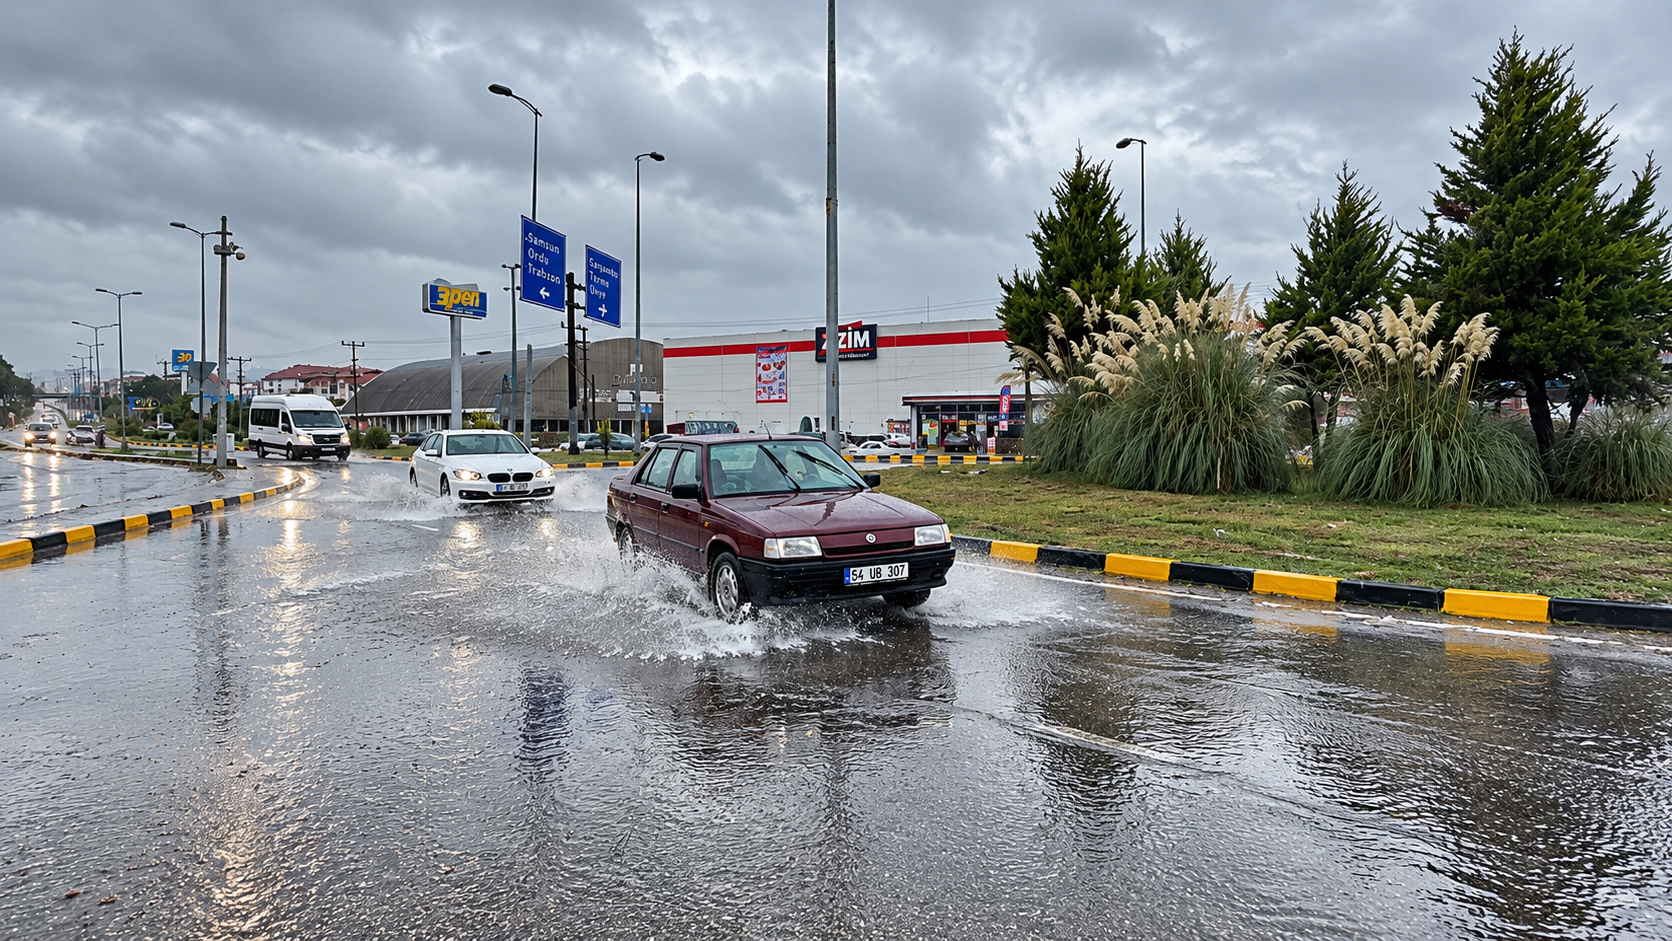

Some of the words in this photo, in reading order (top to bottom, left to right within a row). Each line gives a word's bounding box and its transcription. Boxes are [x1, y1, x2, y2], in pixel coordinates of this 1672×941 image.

[528, 247, 549, 266] Ordu
[851, 569, 864, 582] 54
[869, 566, 882, 580] UB
[887, 564, 906, 578] 307
